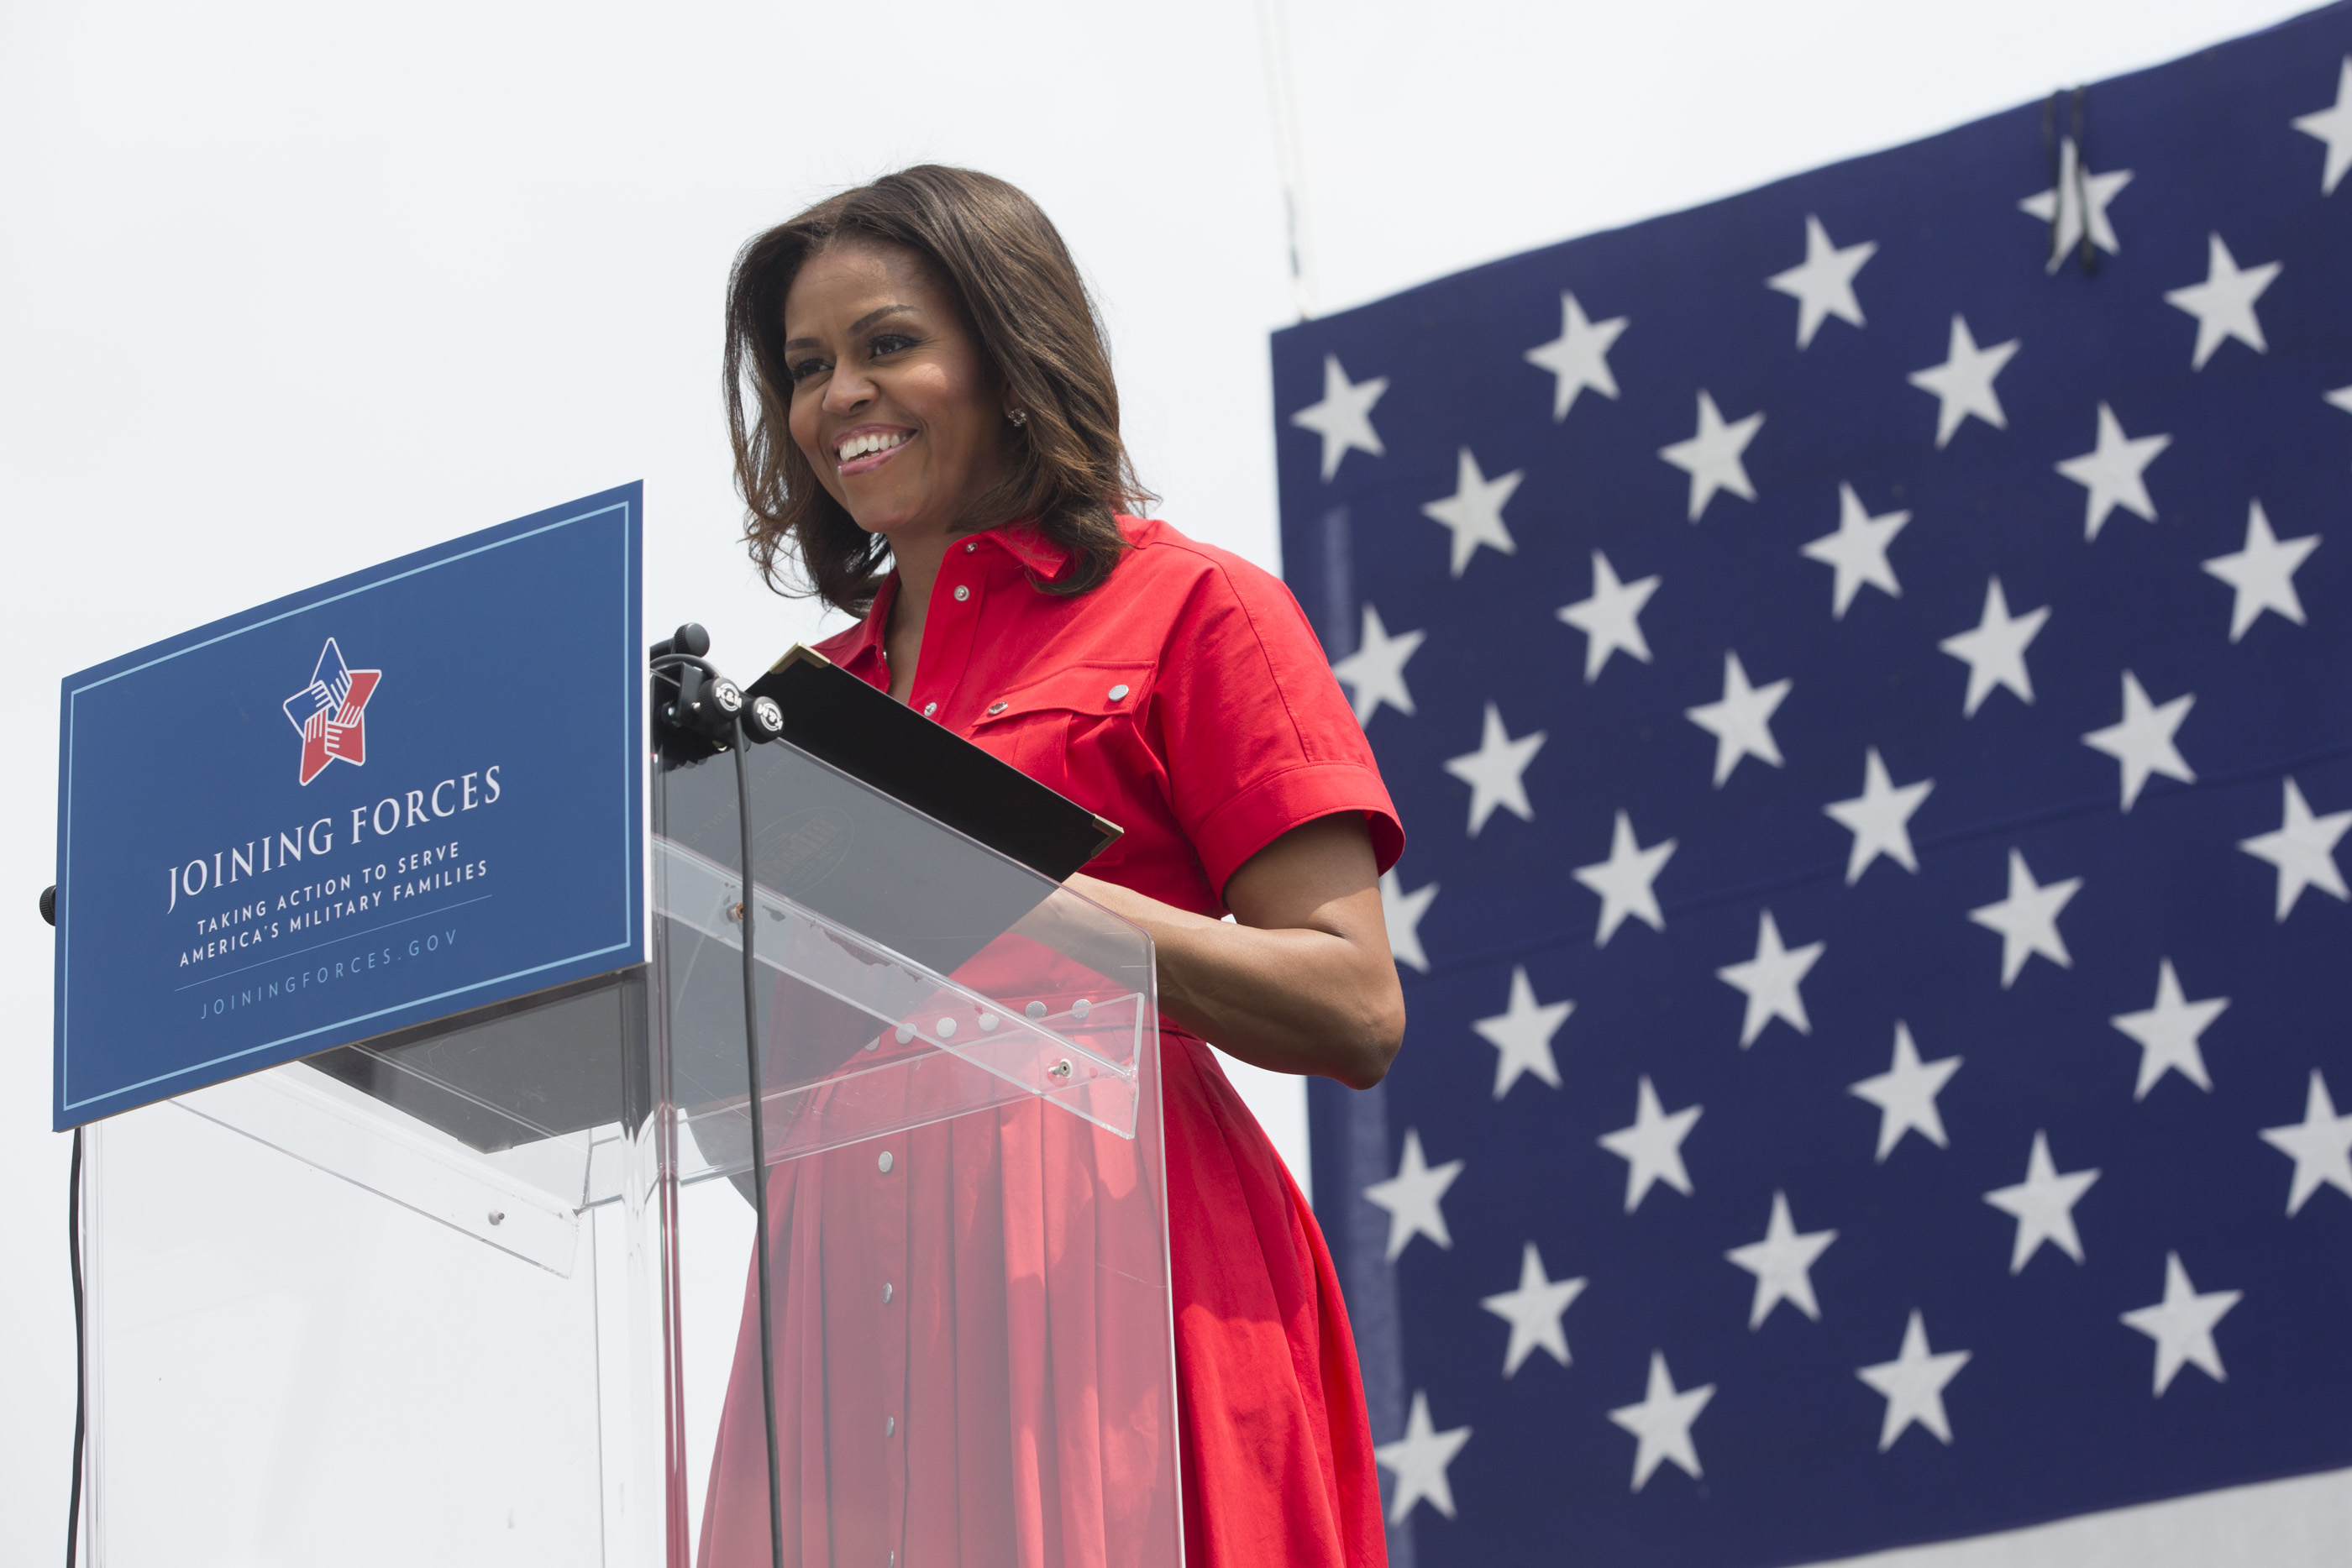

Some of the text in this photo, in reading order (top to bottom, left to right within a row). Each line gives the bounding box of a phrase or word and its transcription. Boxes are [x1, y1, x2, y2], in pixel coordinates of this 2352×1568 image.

[166, 764, 501, 915] JOINING FORCES
[197, 841, 459, 936] TAKING ACTION TO SERVE
[179, 859, 487, 968] AMERICA'S MILITARY FAMILIES
[200, 929, 456, 1020] JOININGFORCES.GOV
